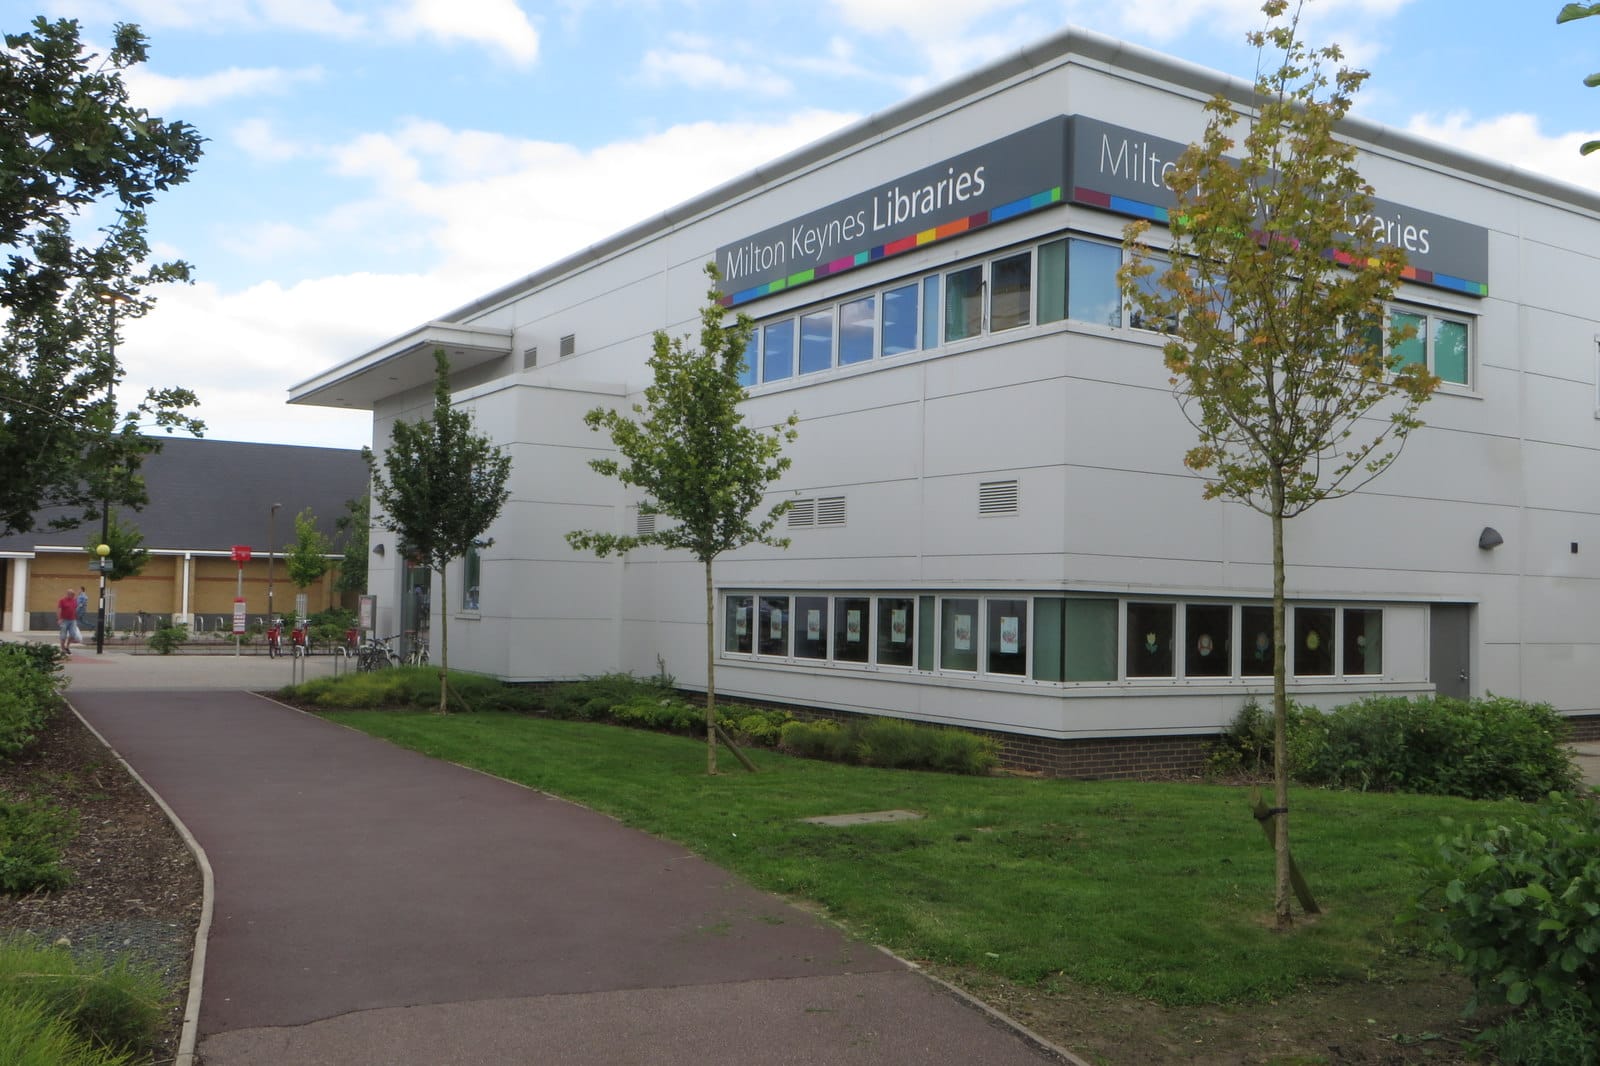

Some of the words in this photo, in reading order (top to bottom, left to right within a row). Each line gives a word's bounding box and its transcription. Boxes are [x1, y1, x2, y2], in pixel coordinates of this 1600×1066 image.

[725, 240, 785, 282] Milton
[791, 210, 865, 261] Keynes
[873, 166, 986, 231] Libraries
